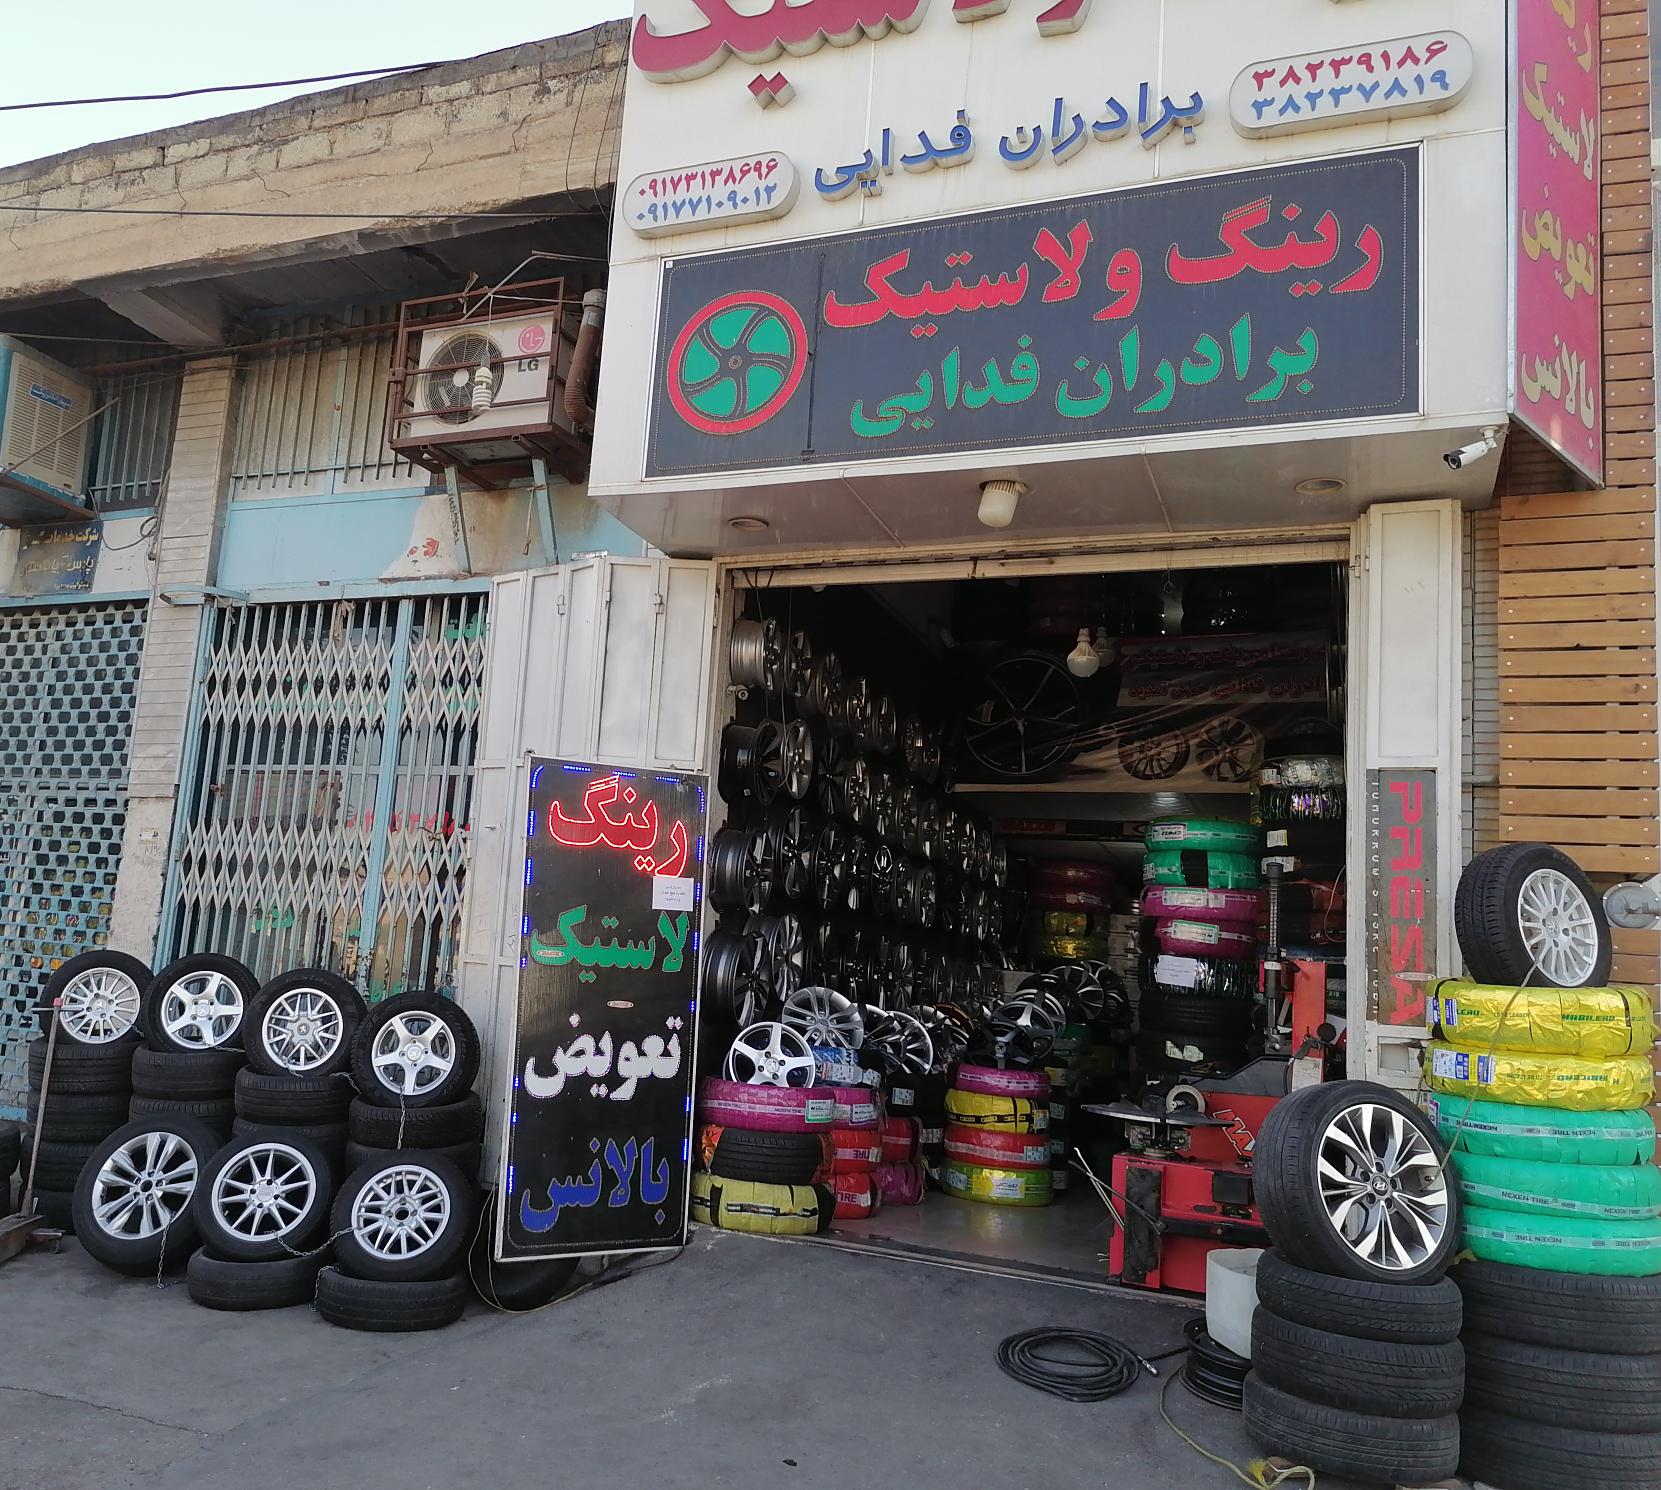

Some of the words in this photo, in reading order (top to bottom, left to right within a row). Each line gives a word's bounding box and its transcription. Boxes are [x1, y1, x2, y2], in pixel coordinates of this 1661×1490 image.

[1250, 69, 1450, 121] ۳۸۲۳۷۸۱۹
[1251, 39, 1448, 92] ۳۸۲۳۹۱۸۶
[813, 108, 976, 199] فدایی
[998, 81, 1205, 170] برادران
[1522, 61, 1596, 182] لاستیک
[635, 182, 778, 224] ۰۹۱۷۷۱۰۹۰۱۲
[638, 157, 779, 199] ۰۹۱۷۳۱۳۸۶۹۶
[823, 218, 1094, 339] لاستیک
[1093, 247, 1143, 321] و
[1164, 194, 1384, 298] رینگ
[1521, 183, 1597, 301] تعویض
[517, 358, 539, 373] LG
[849, 333, 1041, 439] فدایی
[1054, 311, 1320, 420] برادران
[1520, 333, 1596, 451] بالانس
[548, 775, 689, 878] رینگ
[529, 903, 690, 984] لاستیک
[1389, 780, 1424, 1025] PRESA
[523, 1012, 685, 1102] تعویض
[520, 1136, 670, 1234] بالانس
[1501, 1191, 1529, 1203] NEXEN
[1529, 1196, 1550, 1205] TIRE
